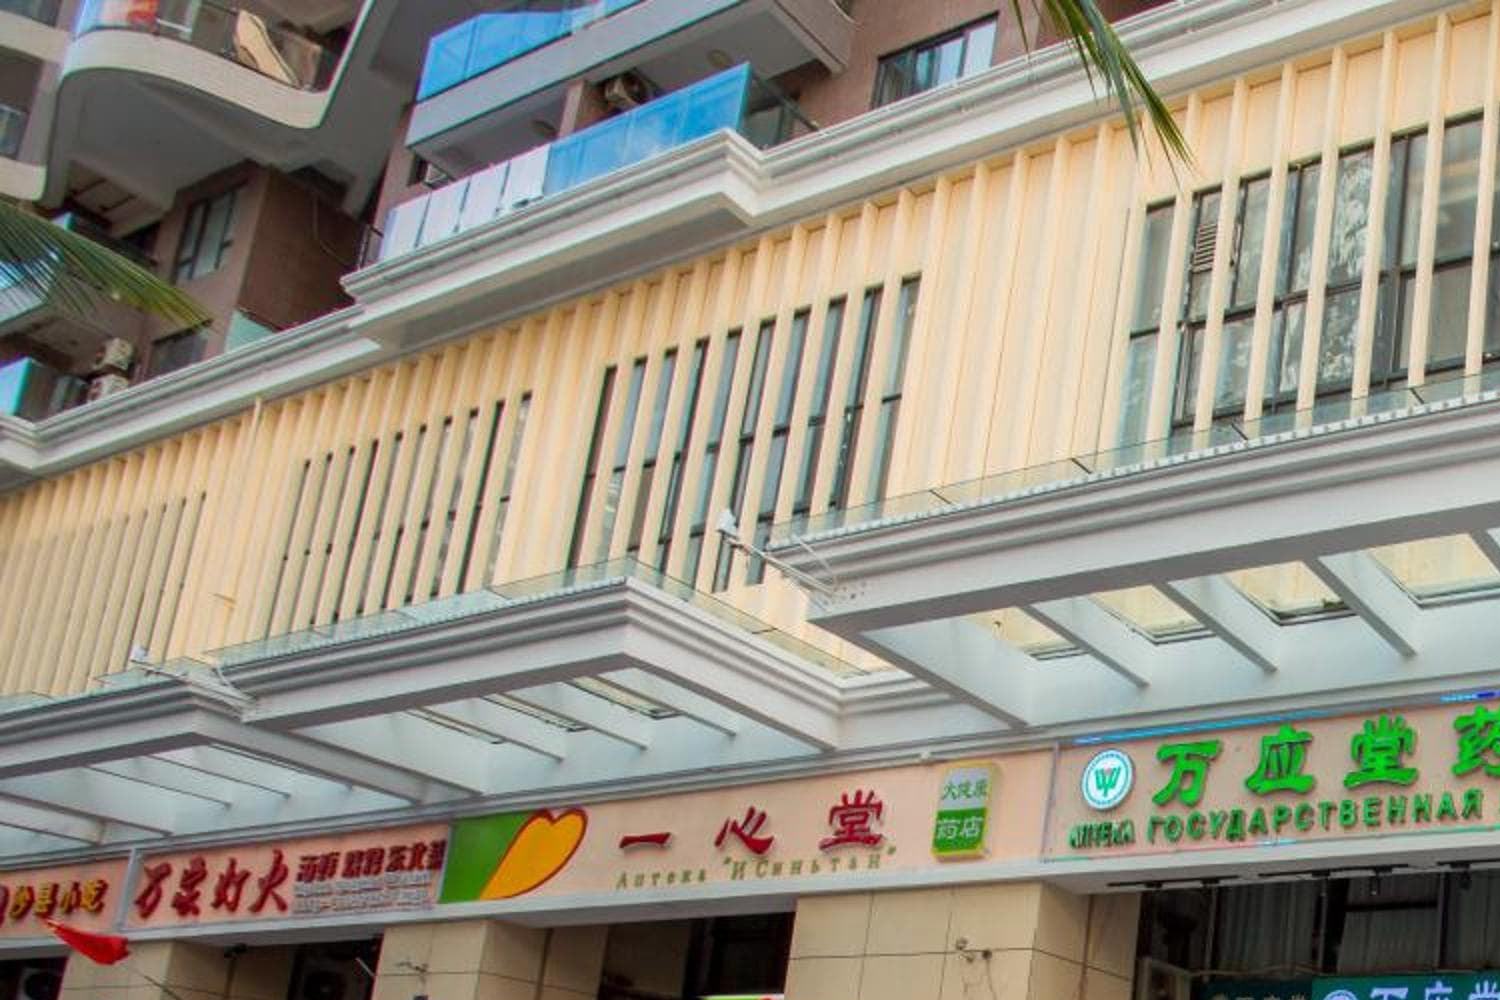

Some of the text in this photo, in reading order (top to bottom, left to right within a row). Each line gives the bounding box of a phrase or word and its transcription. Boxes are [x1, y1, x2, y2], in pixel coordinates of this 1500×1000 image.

[619, 790, 885, 855] 一心堂
[936, 815, 983, 840] 药店
[1148, 787, 1484, 844] ГОСУДАРСТВЕННАЯ
[134, 849, 289, 919] 万家灯火
